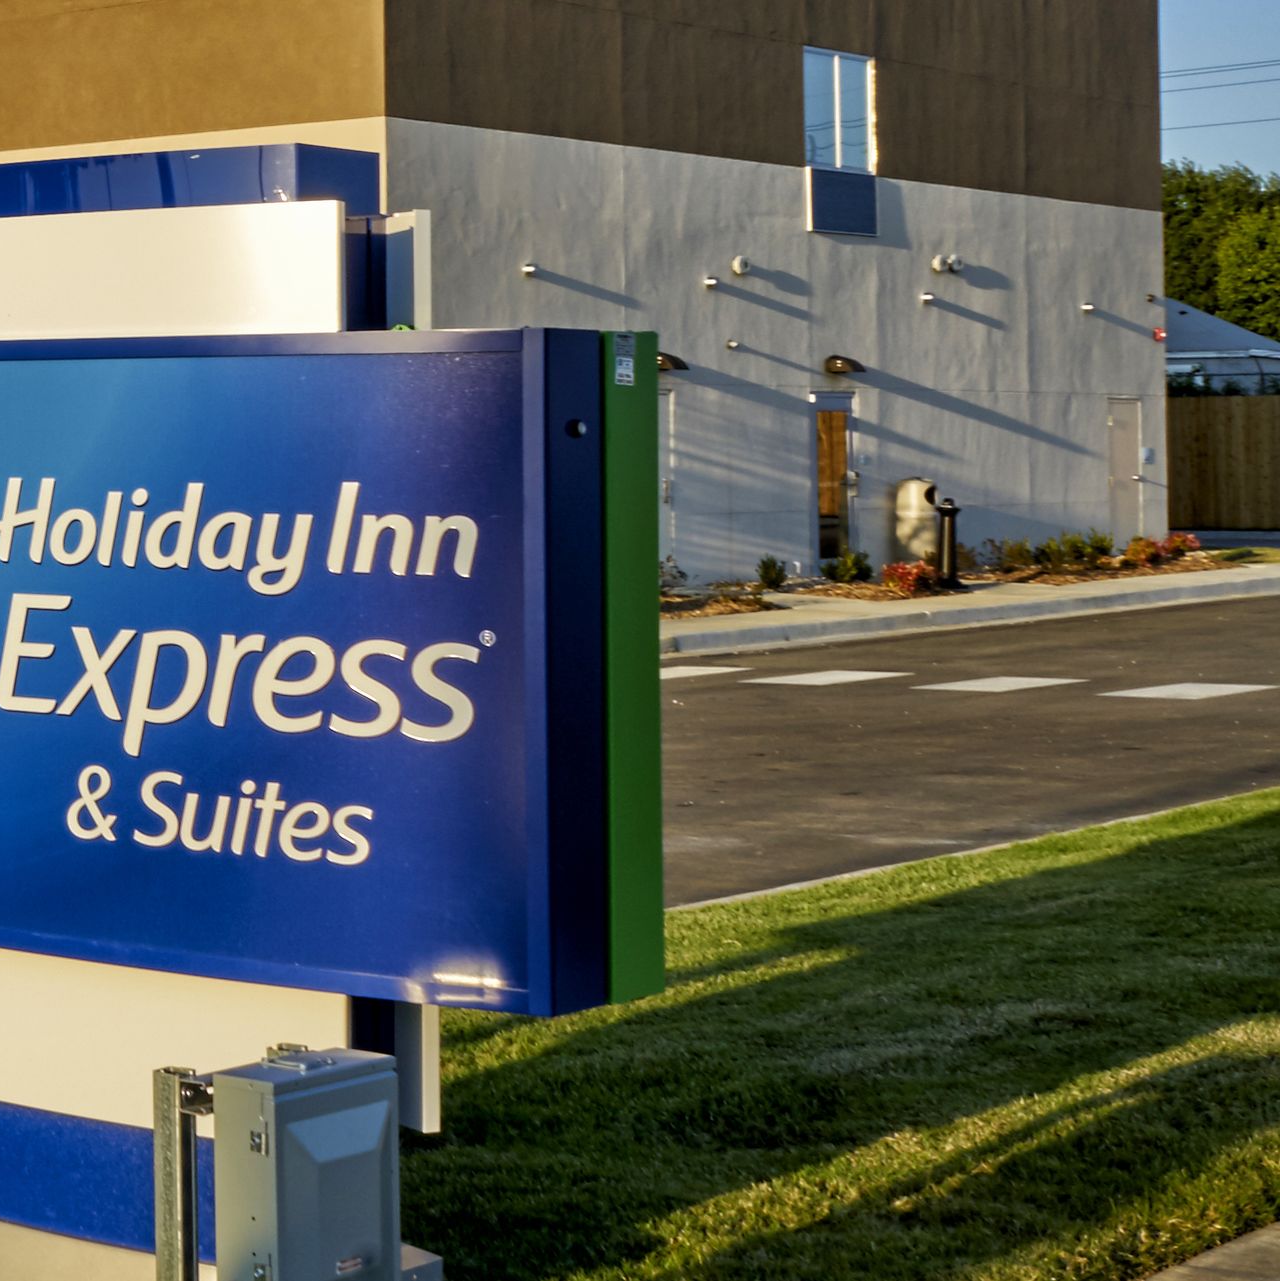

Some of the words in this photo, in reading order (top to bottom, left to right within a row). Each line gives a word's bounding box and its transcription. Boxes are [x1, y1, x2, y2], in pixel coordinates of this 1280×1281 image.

[327, 481, 479, 579] Inn
[66, 764, 118, 842] &
[132, 770, 374, 866] Suites
